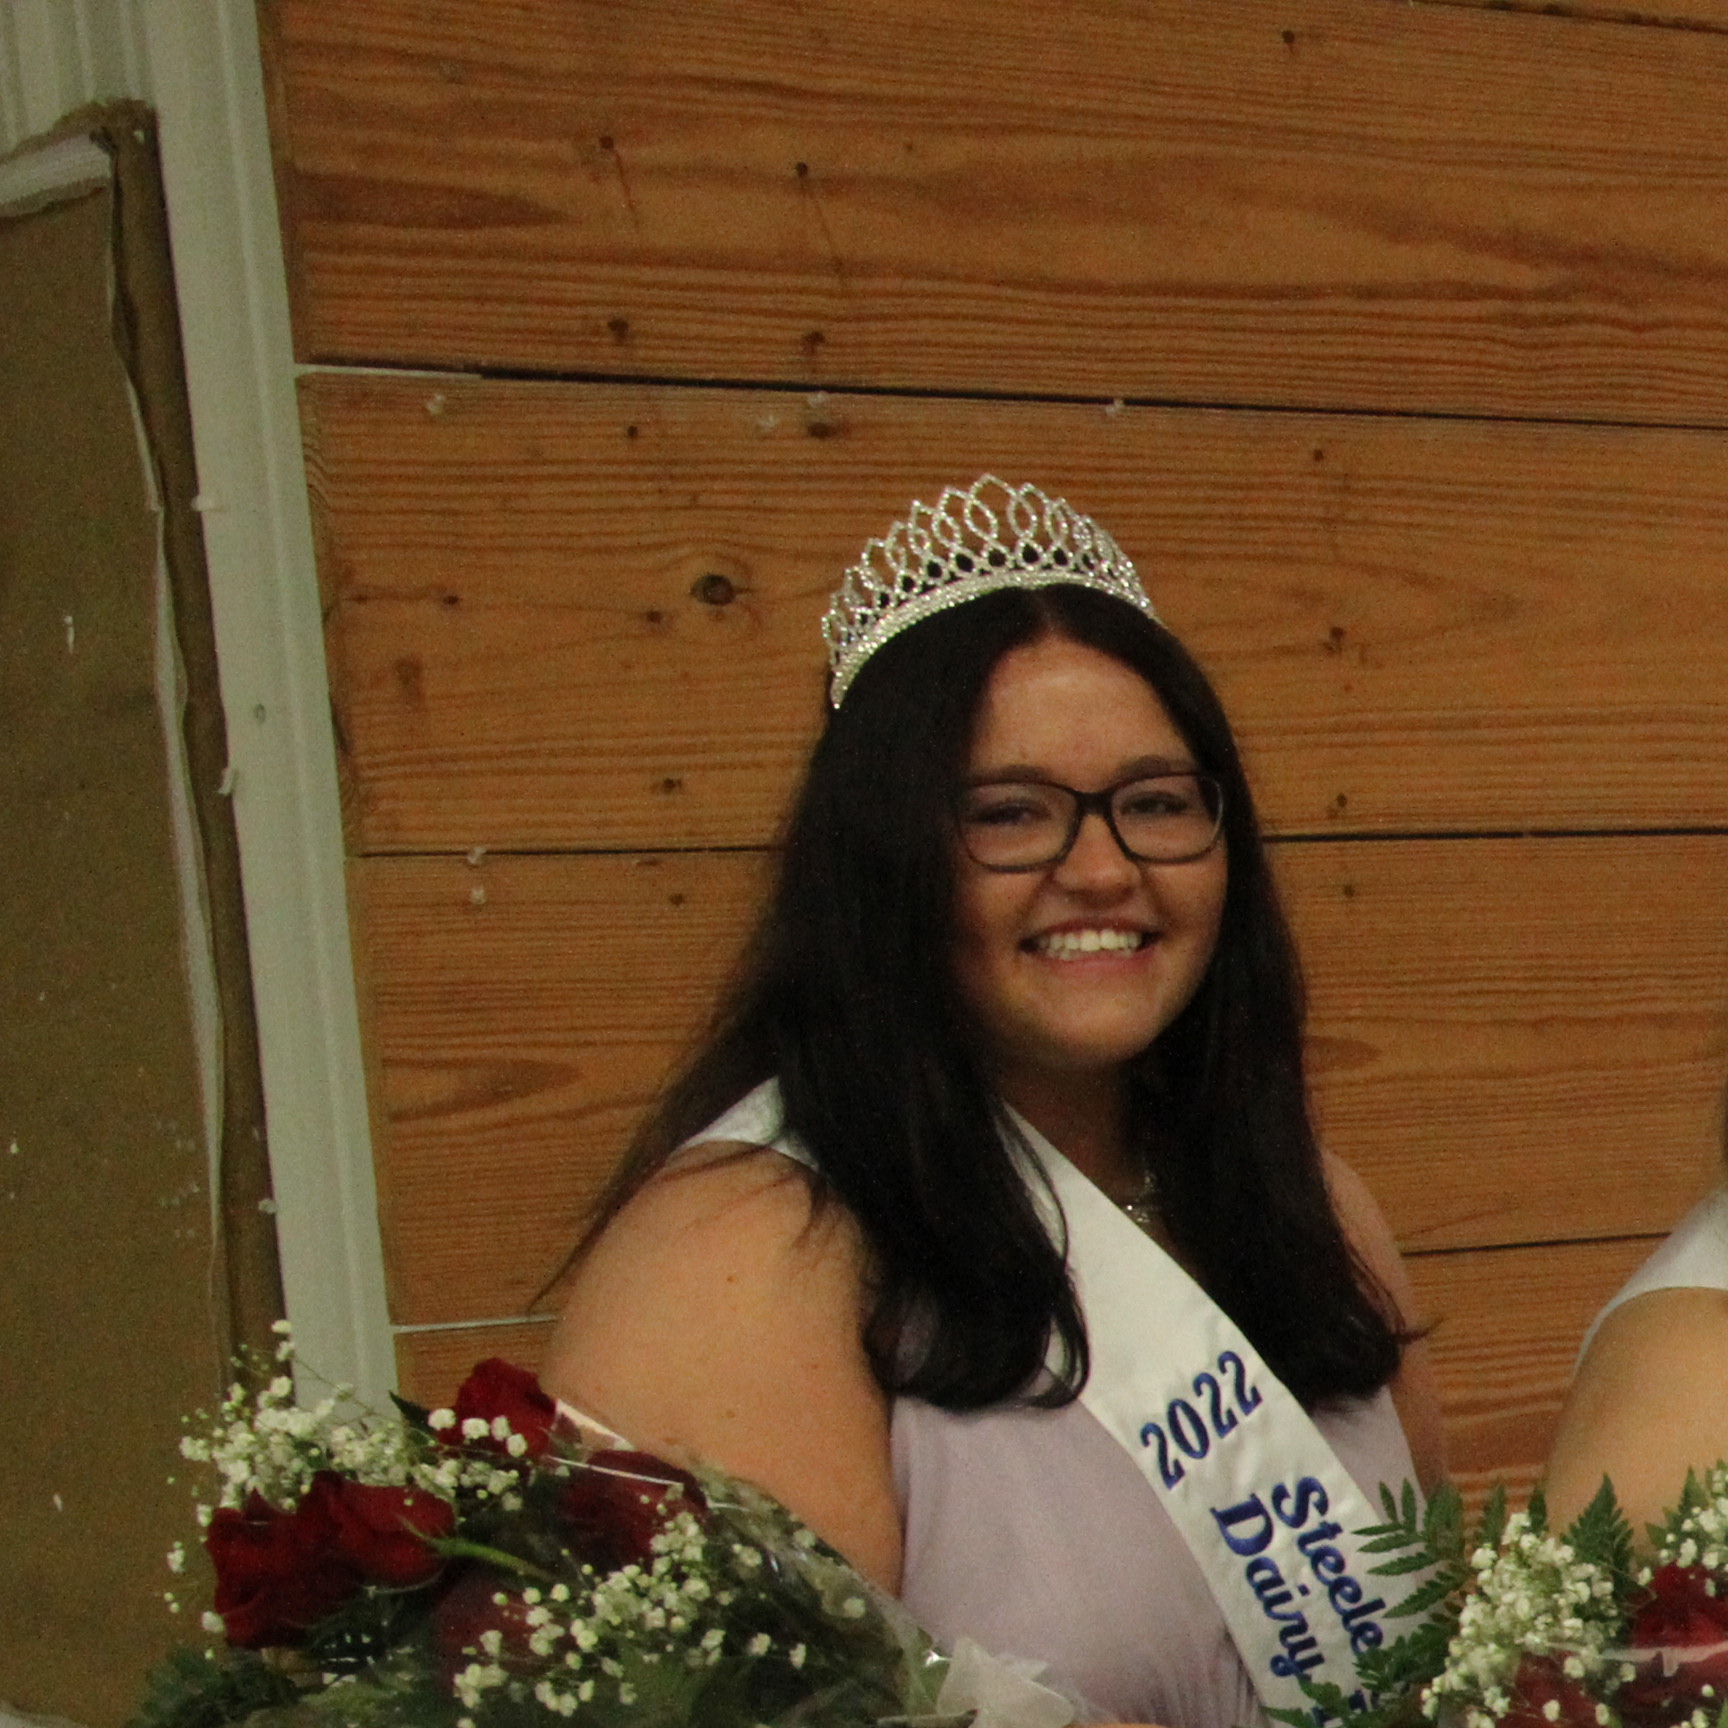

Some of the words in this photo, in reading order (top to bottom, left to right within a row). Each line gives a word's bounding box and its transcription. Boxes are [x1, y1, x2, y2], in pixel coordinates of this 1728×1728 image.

[1139, 1350, 1263, 1491] 2022
[1210, 1492, 1326, 1682] Dairy
[1271, 1475, 1385, 1655] Steele
